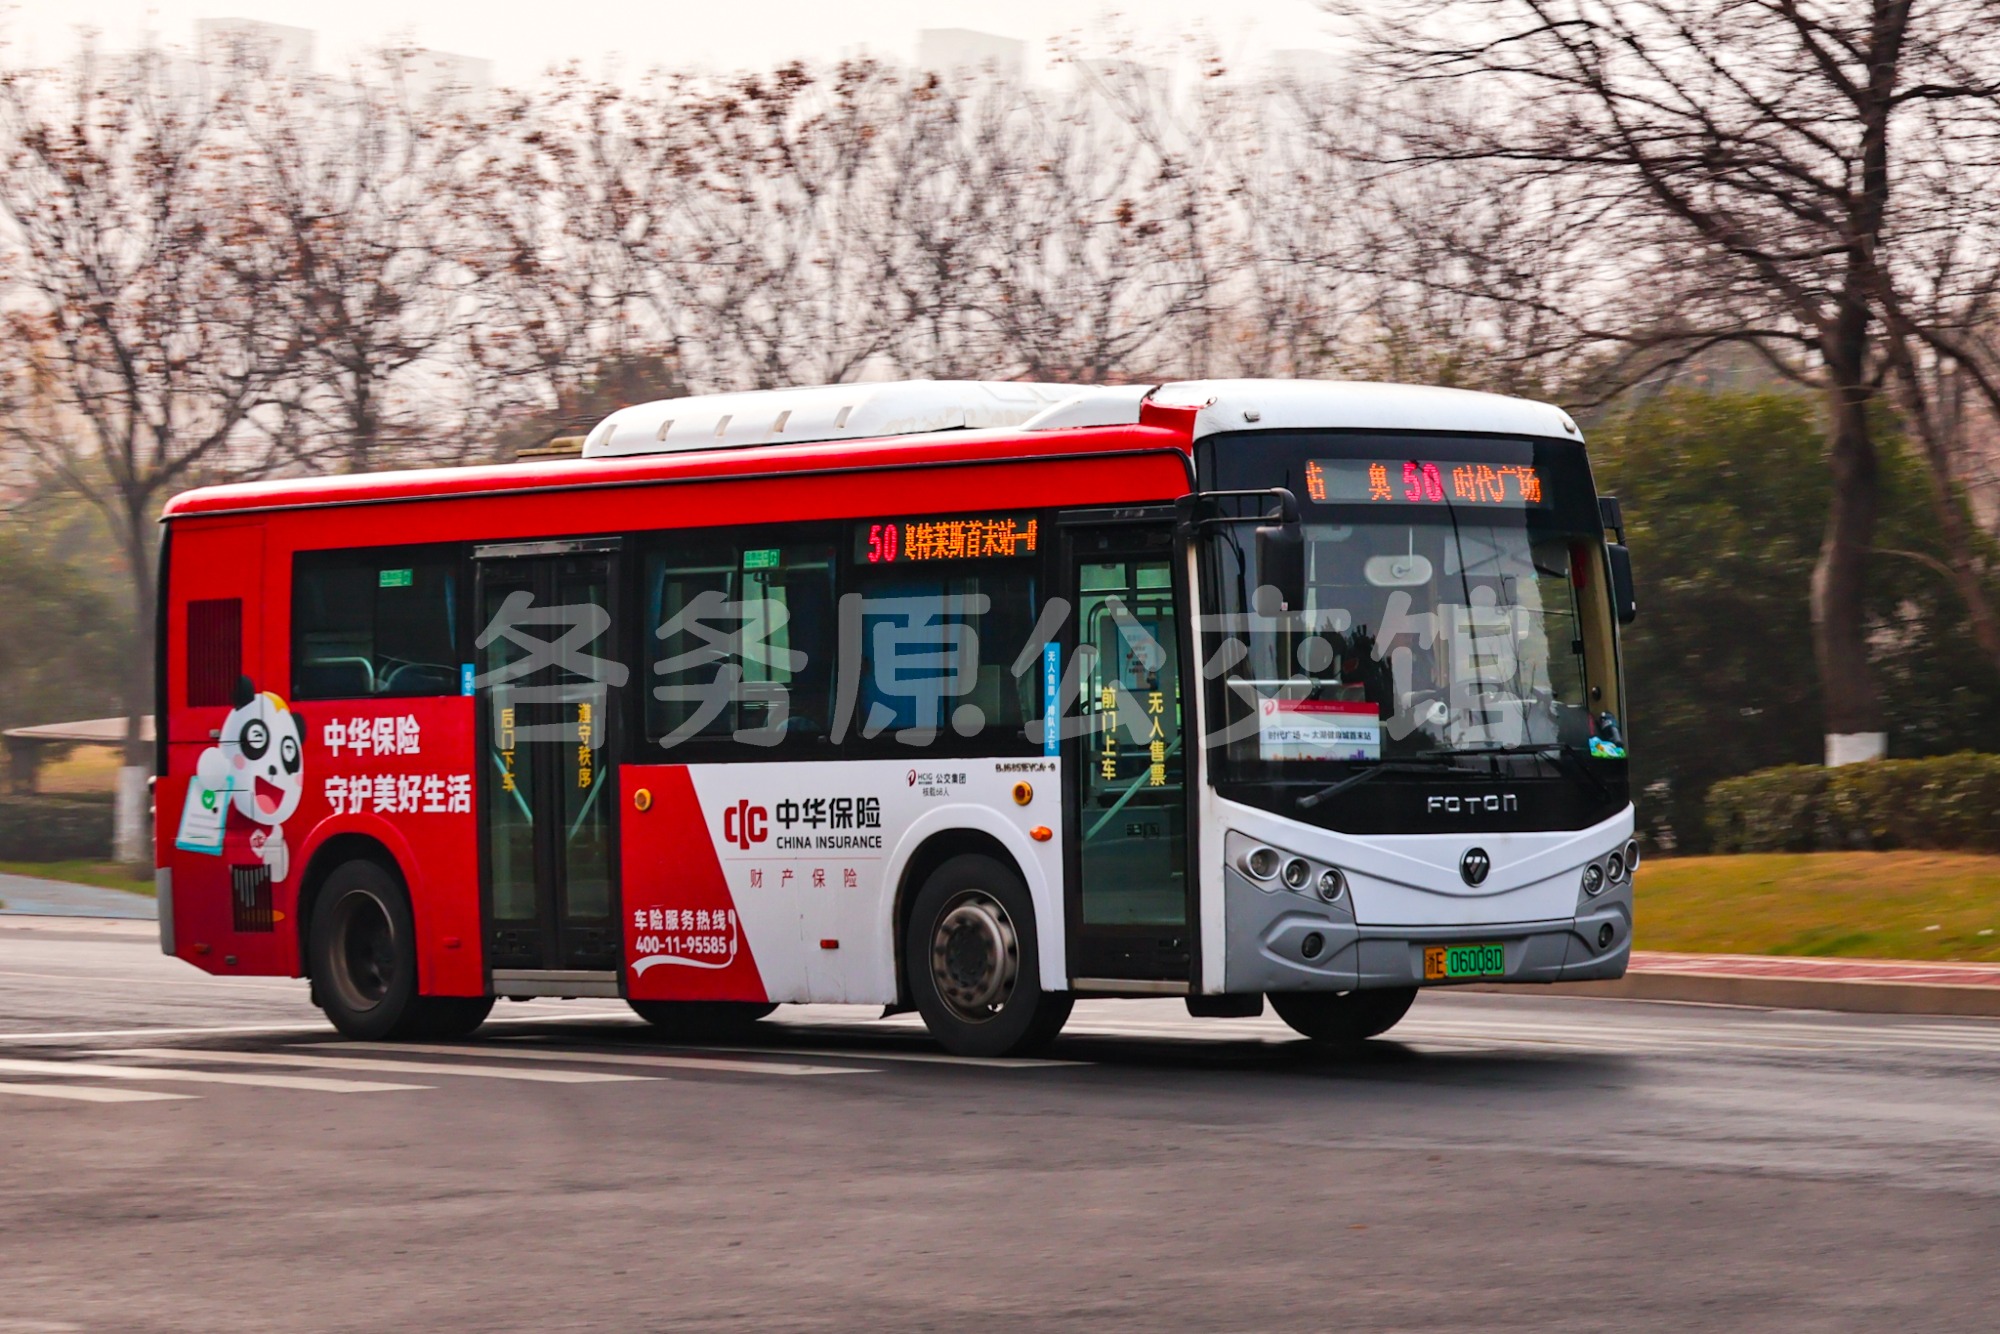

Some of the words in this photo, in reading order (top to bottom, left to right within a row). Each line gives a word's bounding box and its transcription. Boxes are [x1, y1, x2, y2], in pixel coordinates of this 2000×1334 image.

[1402, 463, 1443, 501] 50
[1453, 464, 1540, 502] 时代广场
[868, 524, 898, 562] 50
[324, 714, 420, 757] 中华保险
[501, 708, 515, 792] 后门下车
[578, 703, 592, 788] 遵守秩序
[1101, 687, 1116, 780] 前门上车
[1148, 692, 1166, 786] 无人售票
[325, 774, 471, 813] 守护美好生活
[936, 772, 966, 784] 公交集团
[776, 798, 881, 829] 中华保险
[1427, 794, 1518, 814] FOTON
[776, 836, 812, 849] CHINA
[816, 836, 882, 849] INSURANCE
[750, 868, 857, 888] 财产保险
[634, 909, 727, 931] 车险服务热线
[636, 935, 727, 954] 400-11-95585
